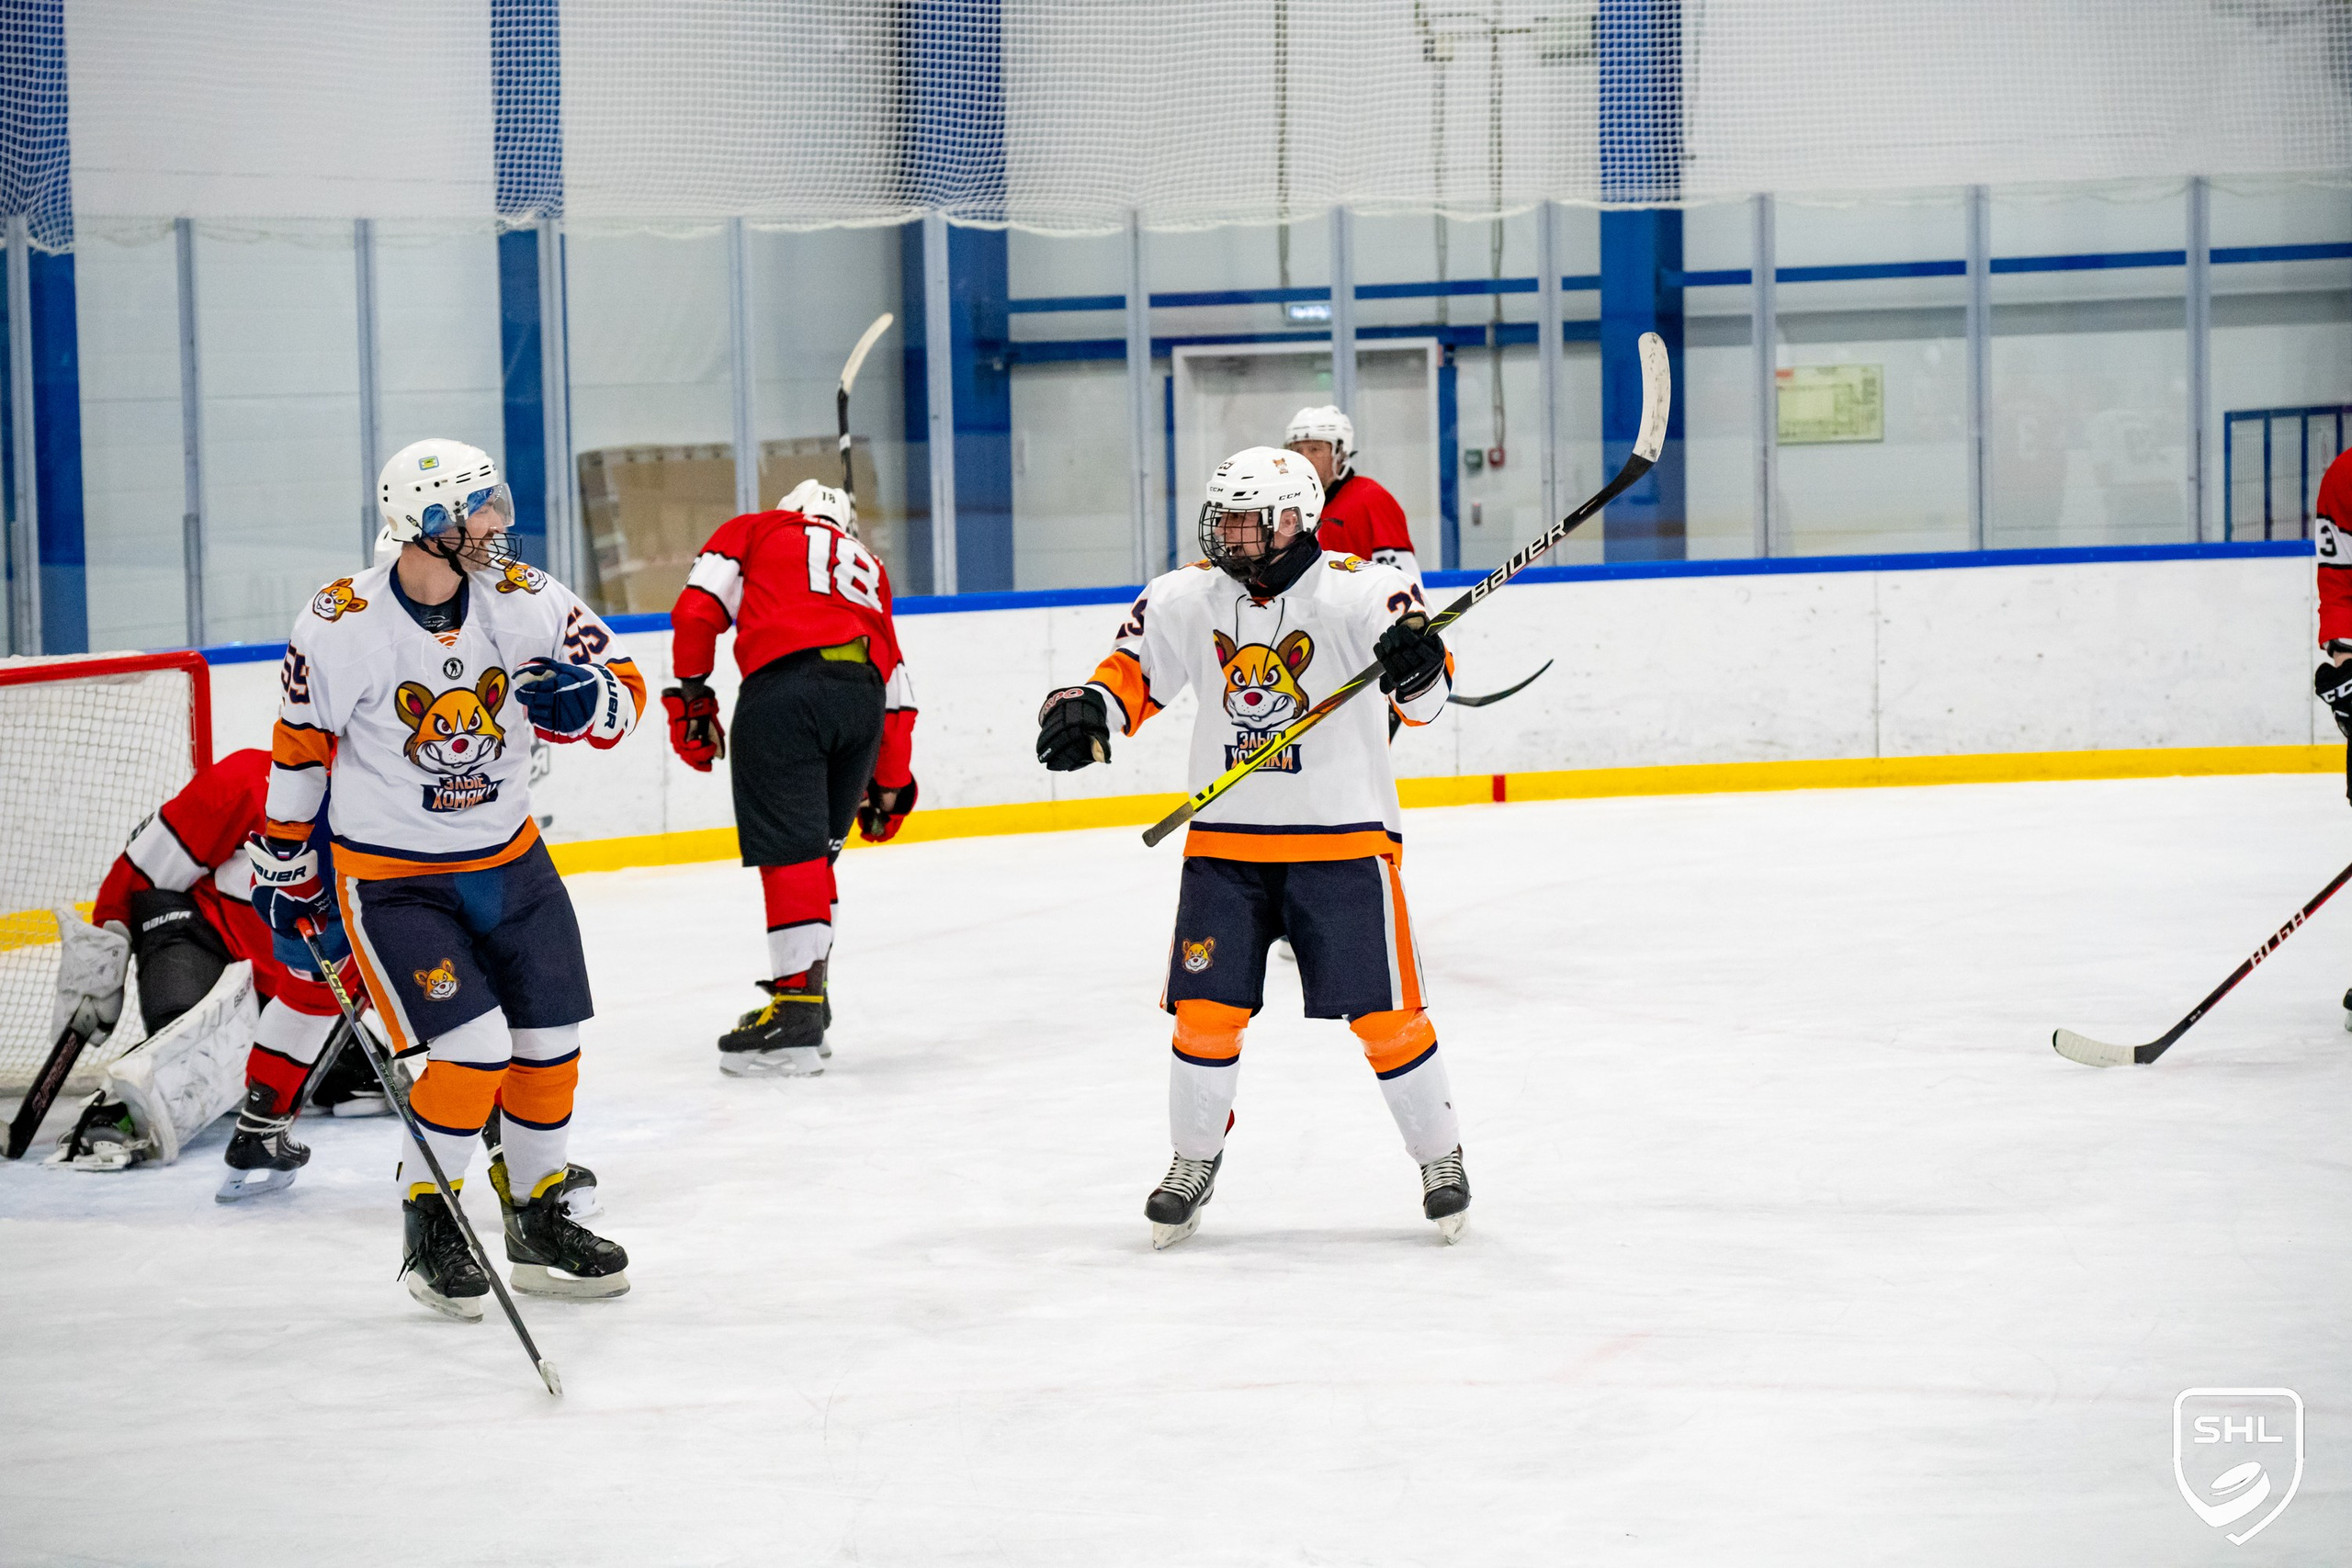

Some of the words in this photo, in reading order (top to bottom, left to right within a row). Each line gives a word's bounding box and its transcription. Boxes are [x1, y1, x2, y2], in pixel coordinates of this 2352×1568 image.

[1278, 491, 1302, 501] CCM
[804, 525, 883, 614] 18
[1471, 520, 1566, 604] BAUER
[1231, 745, 1293, 770] ХОКИ
[444, 773, 487, 791] ЗЛЫЕ
[142, 910, 192, 932] BAUER
[322, 960, 352, 1004] CCM
